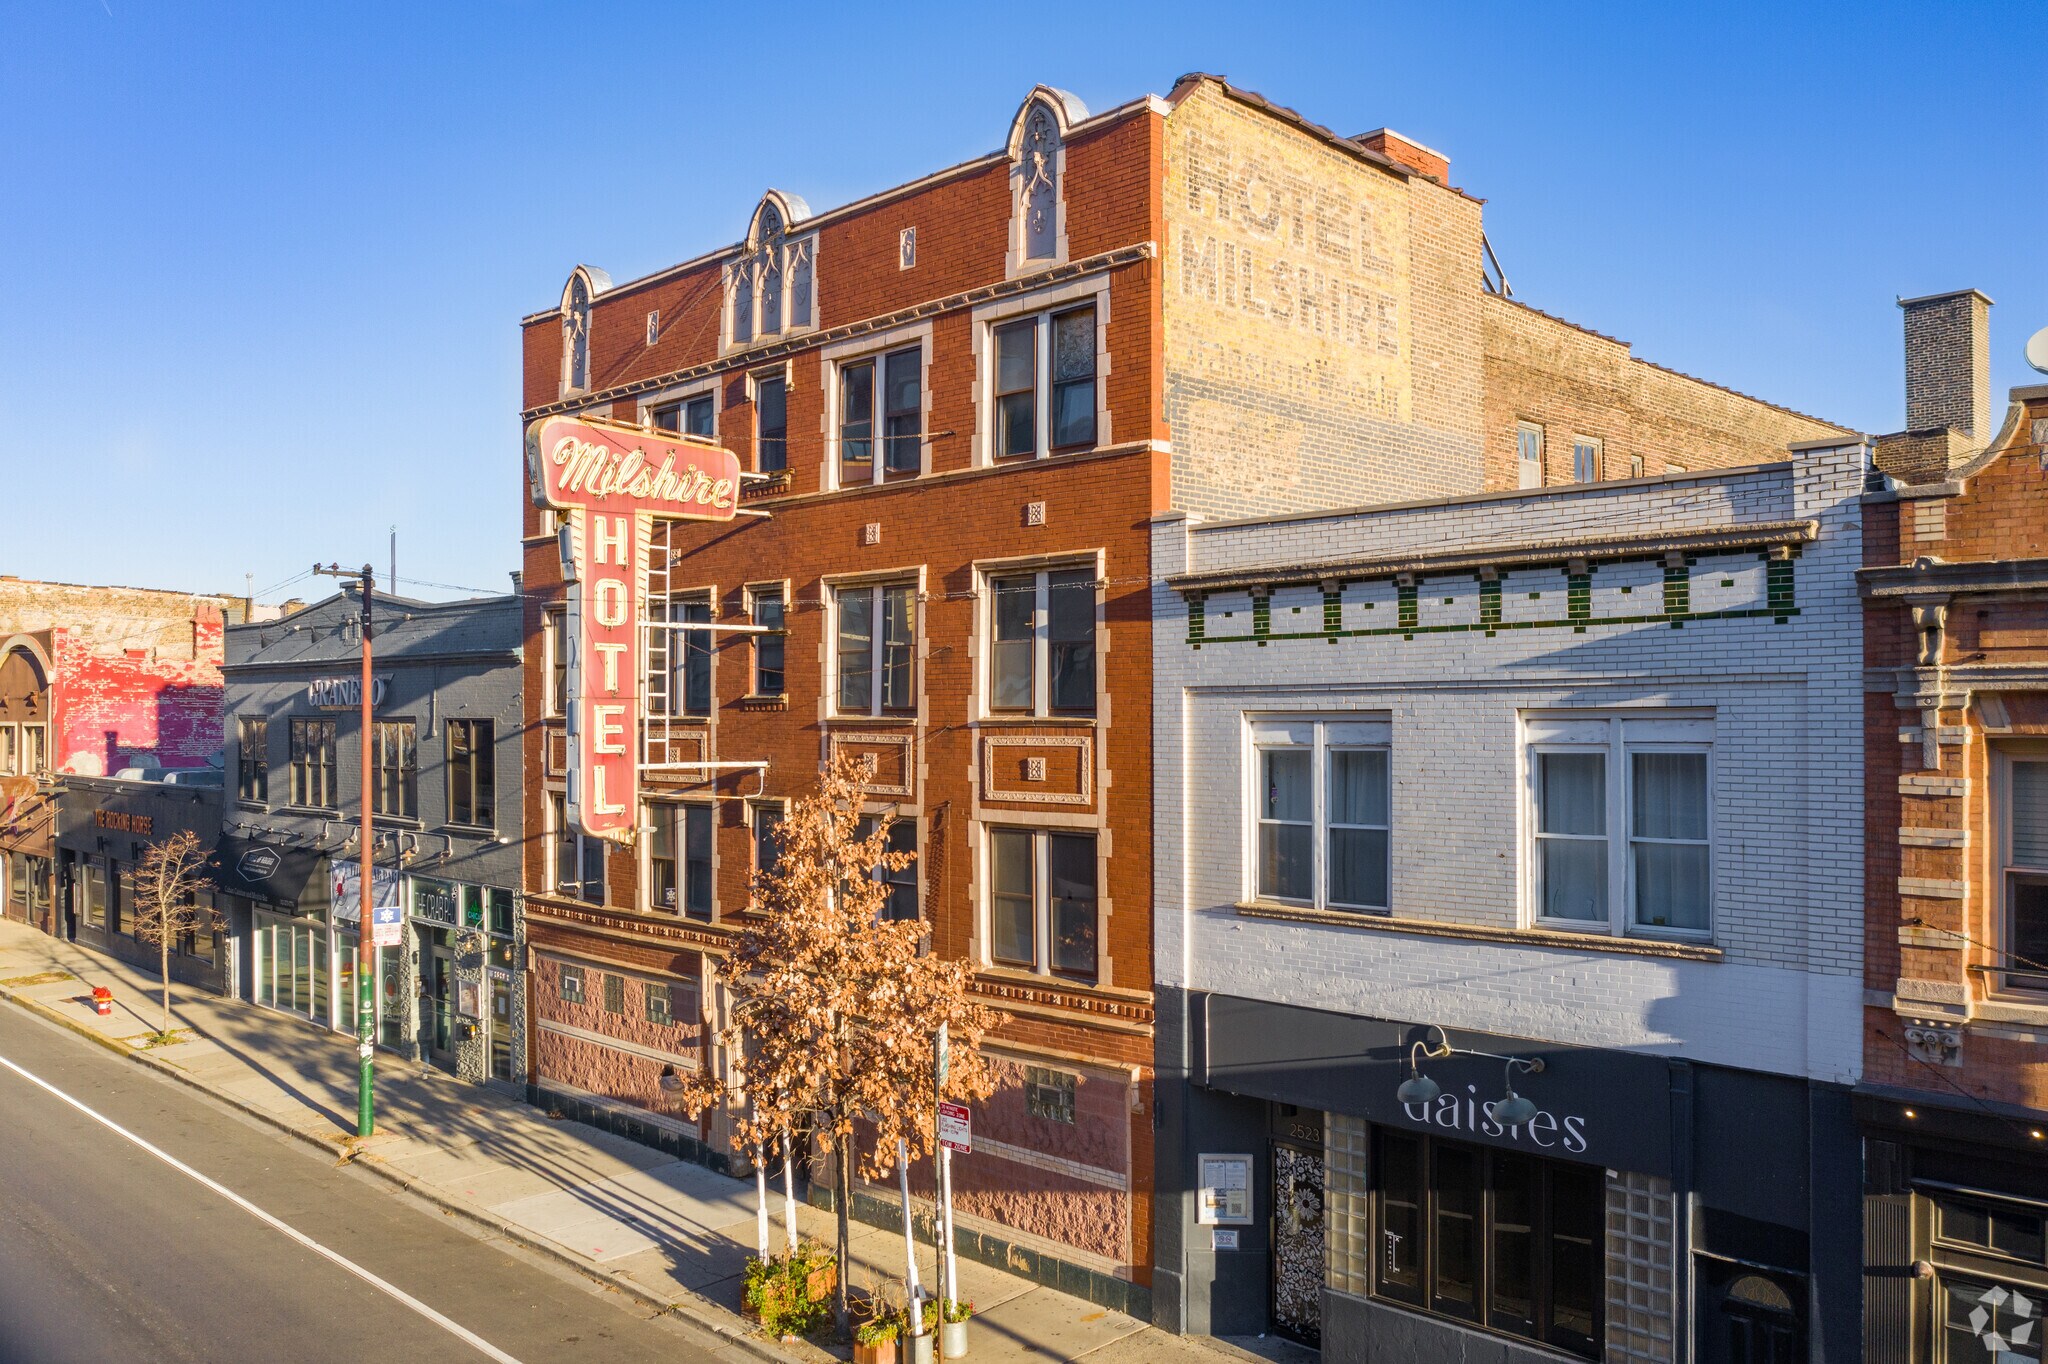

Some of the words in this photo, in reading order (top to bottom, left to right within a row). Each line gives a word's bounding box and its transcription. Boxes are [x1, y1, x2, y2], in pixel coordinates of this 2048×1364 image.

[1187, 130, 1397, 277] HOTEL
[1179, 224, 1398, 355] MILSHIRE
[552, 435, 734, 509] Milshire
[593, 515, 629, 815] HOTEL
[308, 678, 384, 706] GRANEO
[95, 808, 105, 827] THE
[106, 810, 130, 831] ROCKING
[131, 814, 152, 835] HORSE
[426, 893, 444, 921] CRAB
[941, 1139, 953, 1149] TOW
[954, 1142, 968, 1152] ZONE
[1289, 1123, 1320, 1142] 2523
